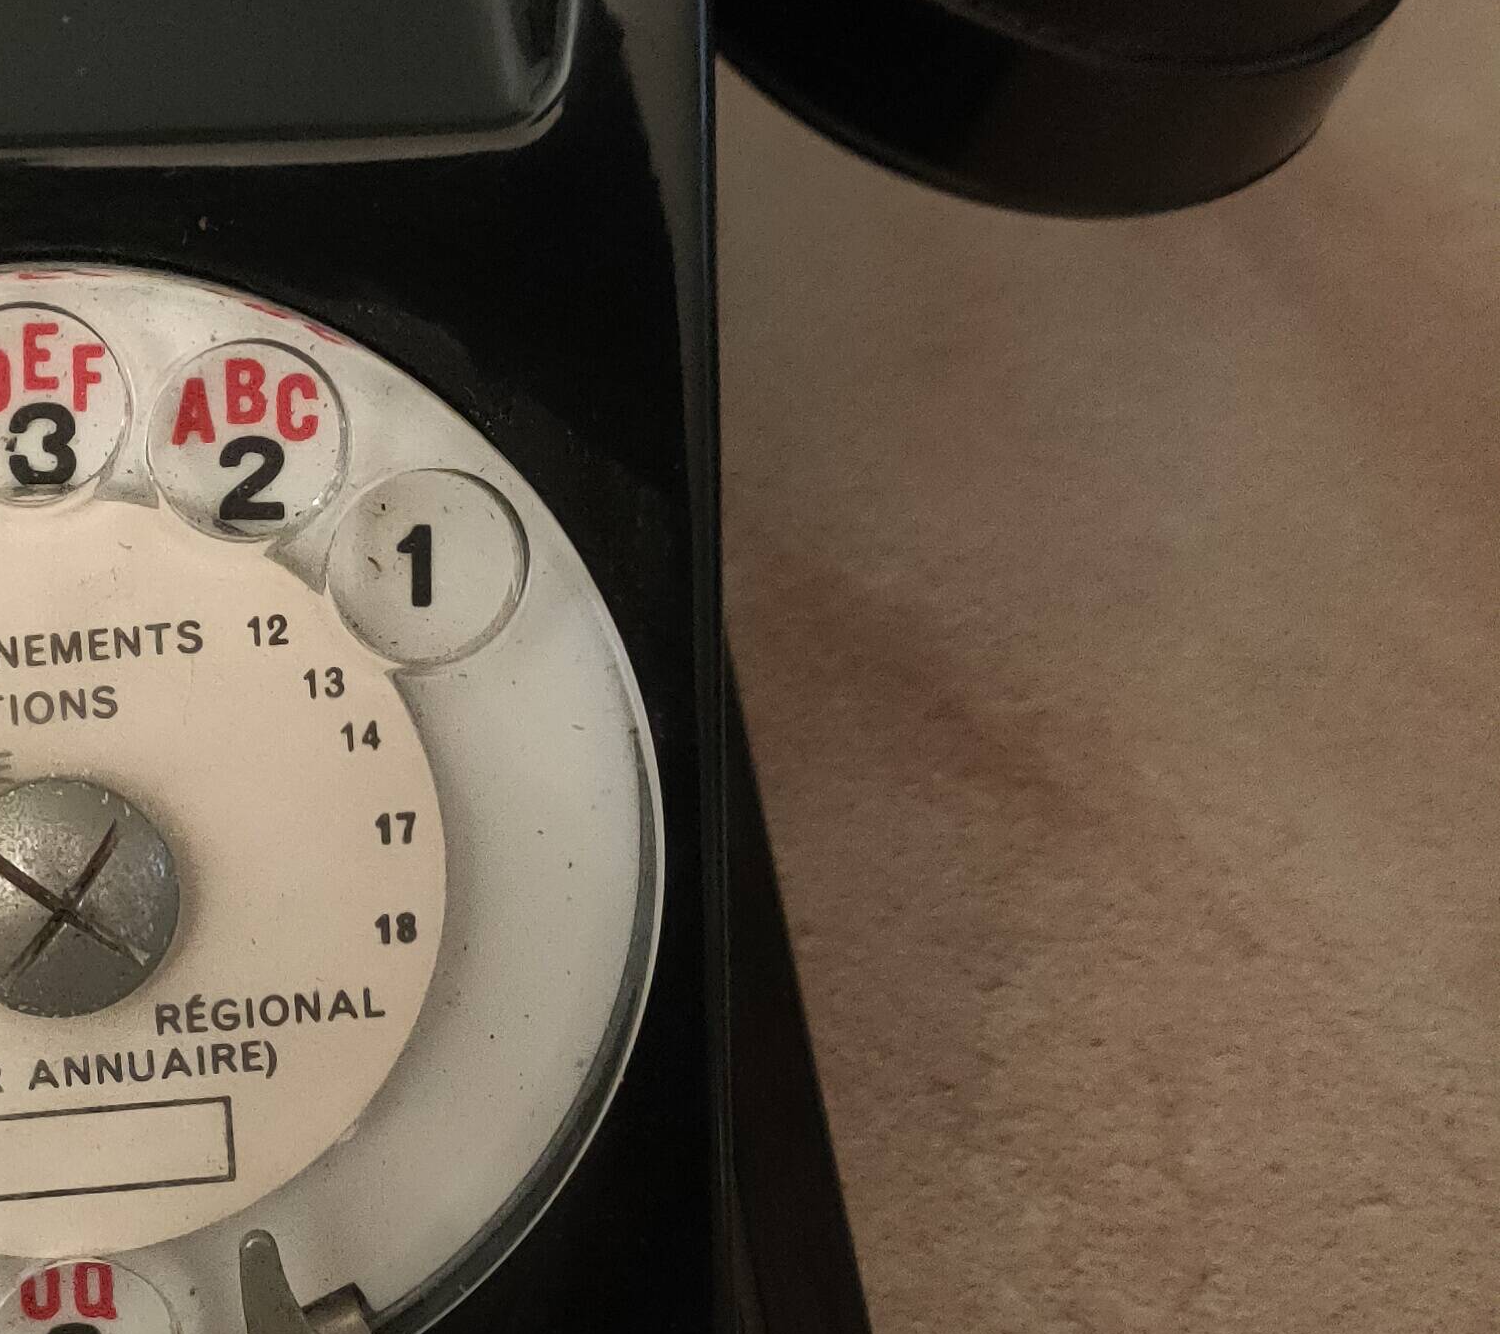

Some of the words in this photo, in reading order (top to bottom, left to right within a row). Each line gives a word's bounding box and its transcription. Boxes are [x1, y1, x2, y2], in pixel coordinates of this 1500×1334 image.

[171, 358, 319, 446] ABC
[8, 401, 78, 486] 3
[218, 435, 286, 522] 2
[397, 524, 432, 607] 1
[248, 614, 289, 646] 12
[304, 667, 344, 699] 13
[341, 721, 381, 752] 14
[376, 812, 416, 845] 17
[375, 912, 417, 944] 18
[155, 987, 385, 1036] RÉGIONAL
[29, 1041, 277, 1090] ANNUAIRE)
